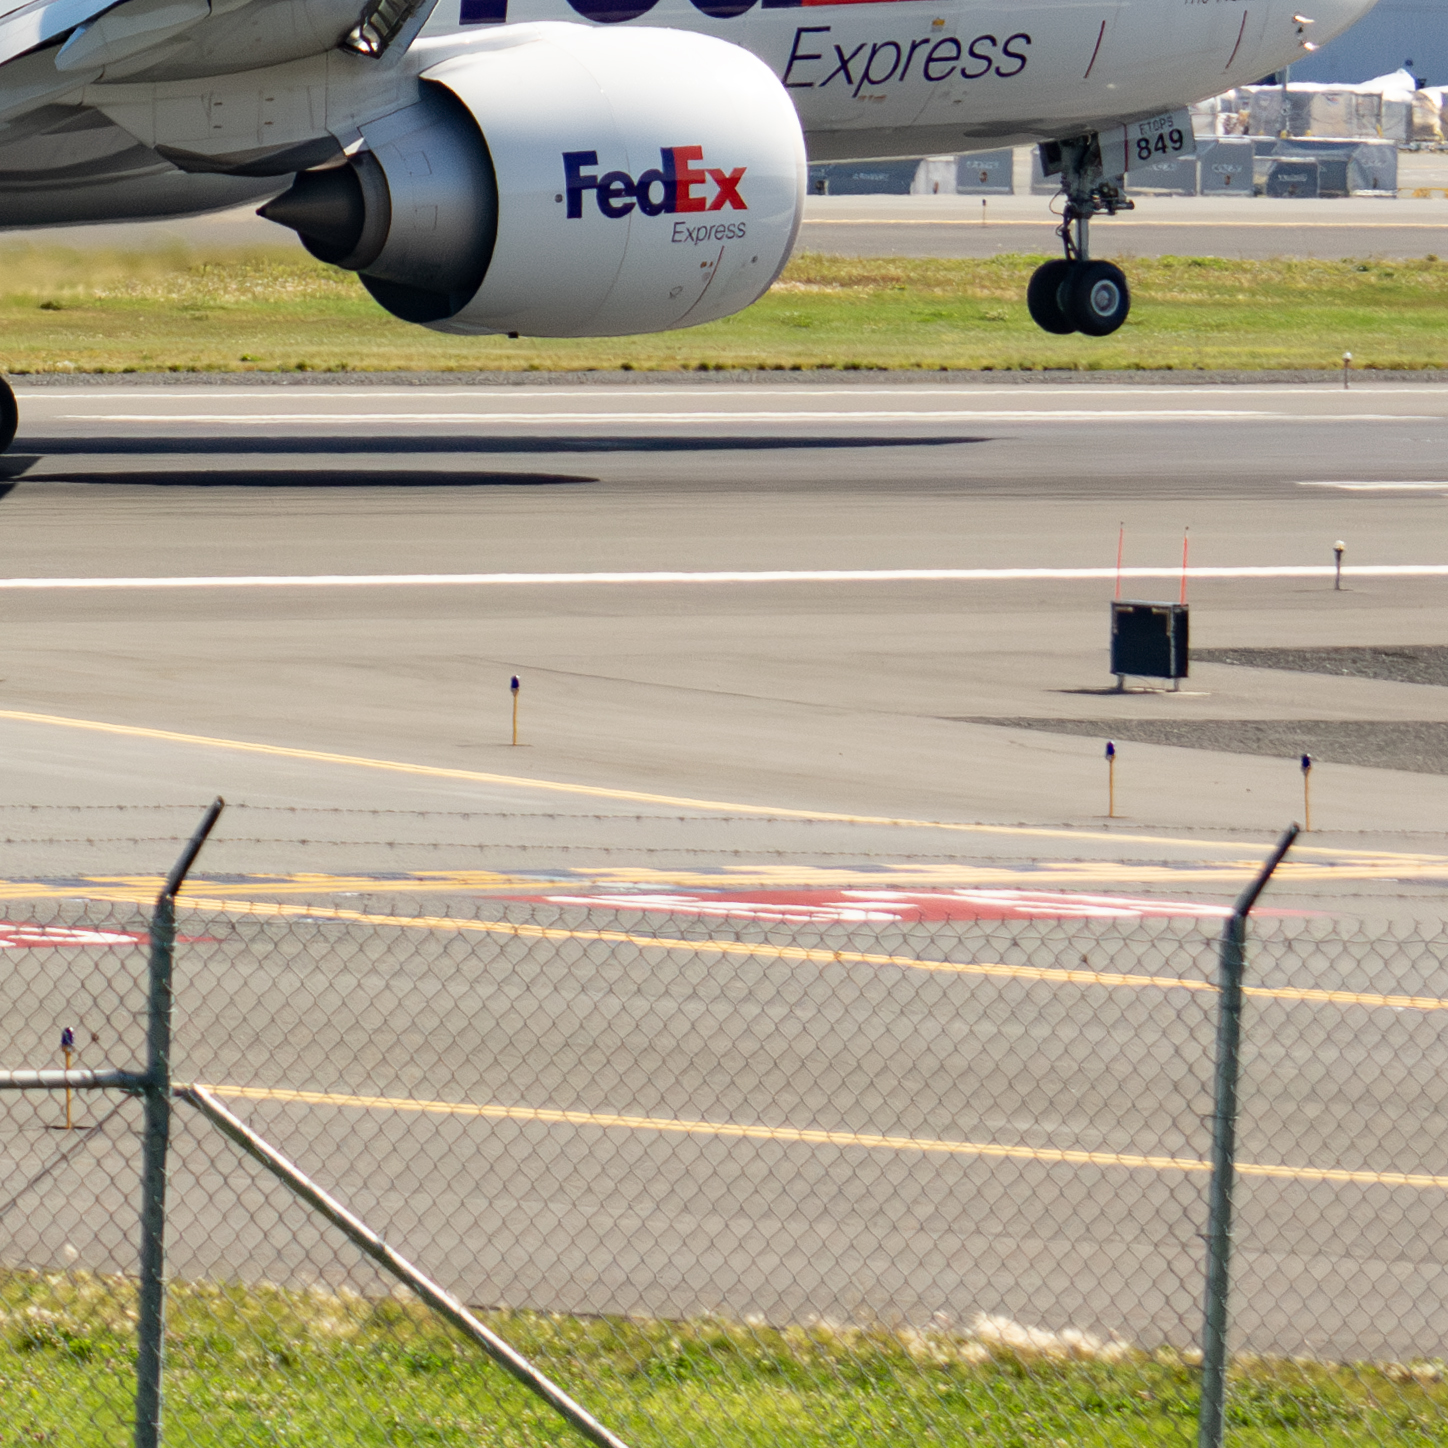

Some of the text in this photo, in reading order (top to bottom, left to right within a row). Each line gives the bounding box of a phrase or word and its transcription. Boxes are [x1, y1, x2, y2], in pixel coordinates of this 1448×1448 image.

[784, 25, 1032, 98] Express
[1136, 128, 1184, 160] 849
[562, 145, 748, 219] FedEx
[671, 221, 747, 245] Express
